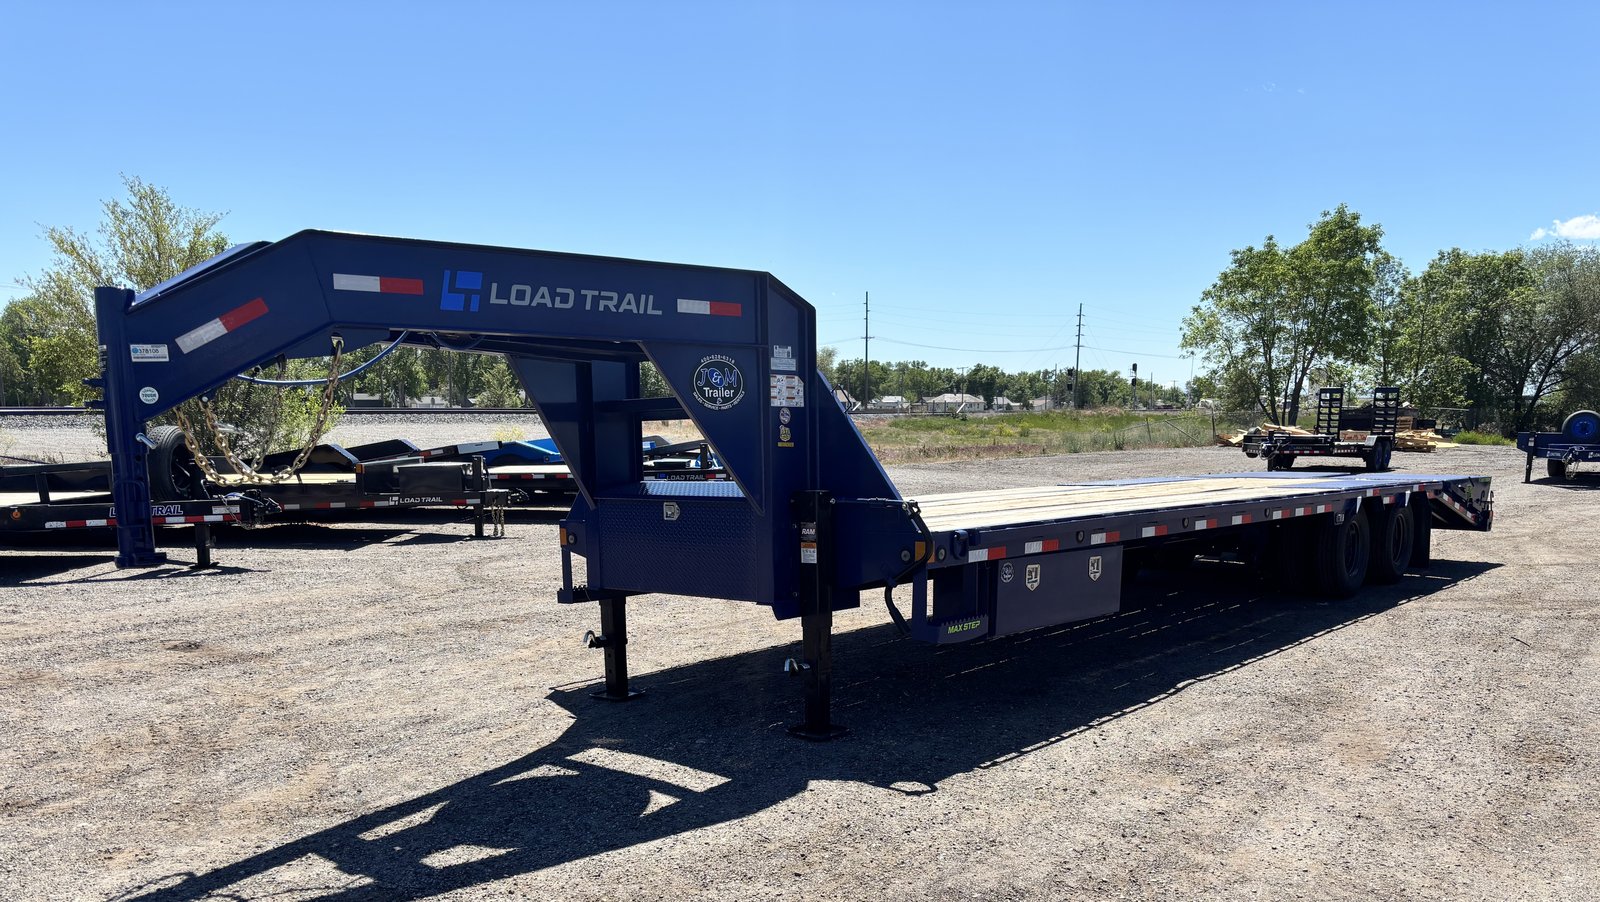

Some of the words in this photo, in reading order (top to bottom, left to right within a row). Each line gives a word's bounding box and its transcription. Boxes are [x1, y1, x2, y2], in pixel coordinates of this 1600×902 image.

[489, 282, 575, 309] LOAD
[580, 289, 663, 315] TRAIL
[703, 387, 735, 398] Trailer
[151, 504, 184, 516] TRAIL
[947, 623, 963, 634] MAX
[963, 620, 981, 631] STEP
